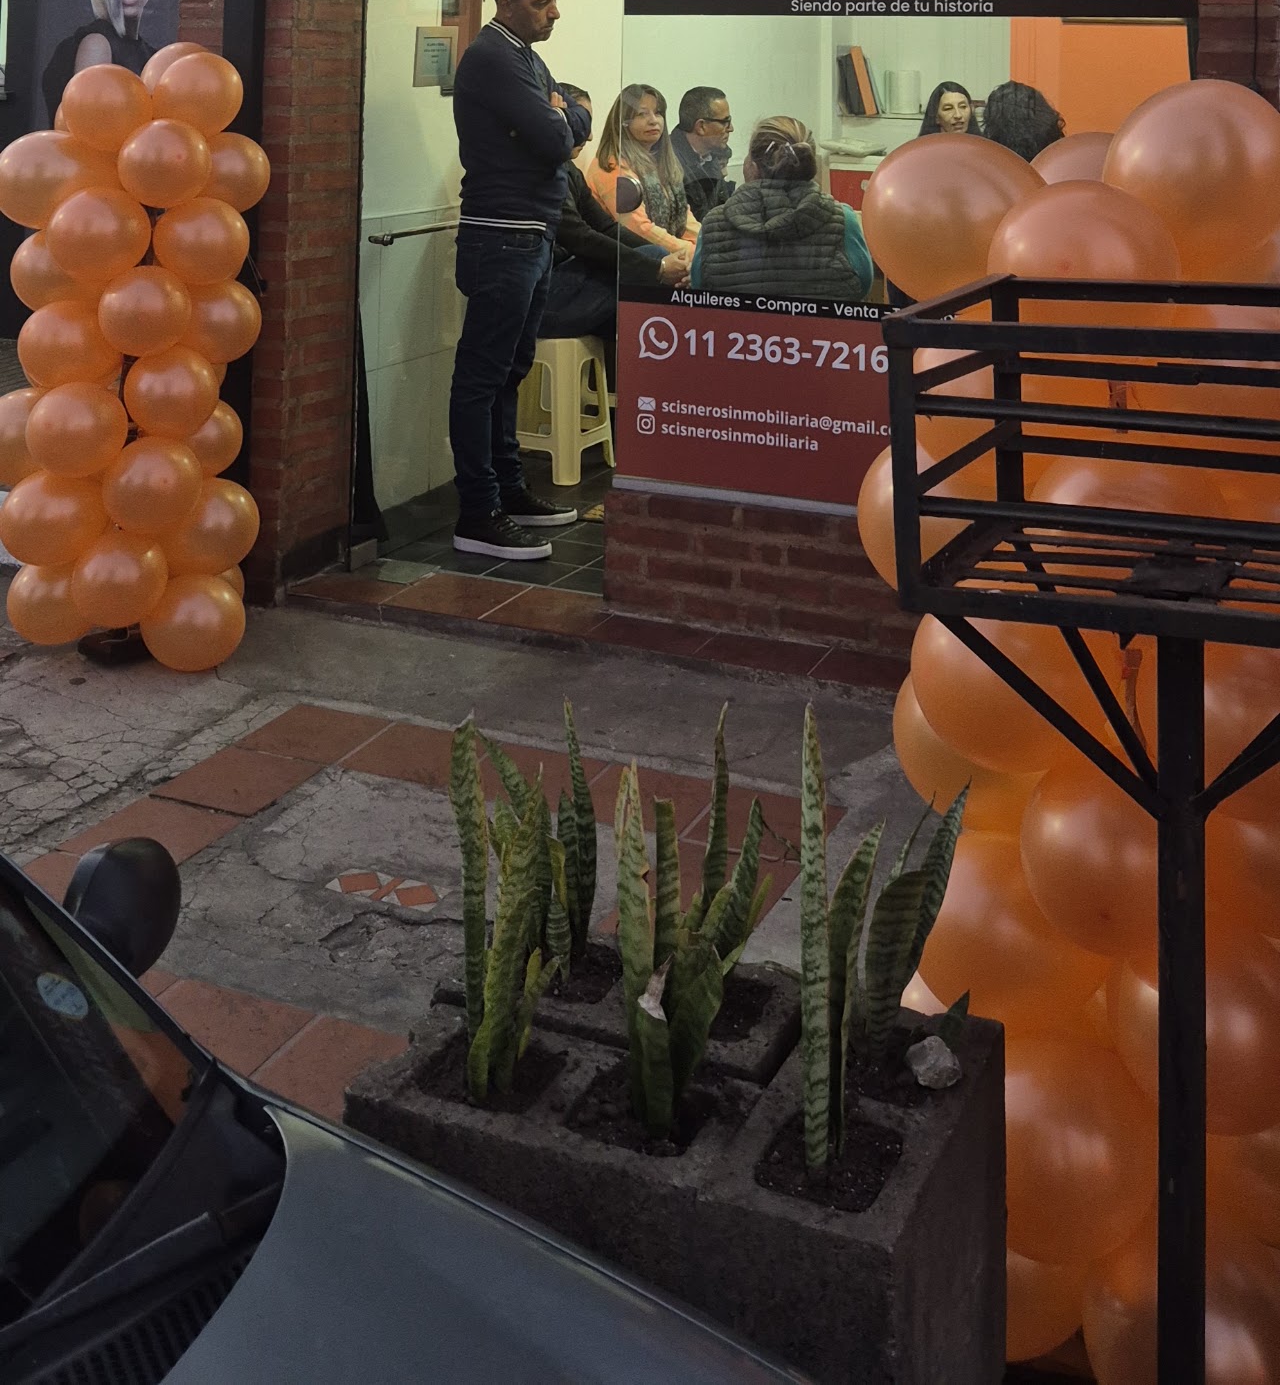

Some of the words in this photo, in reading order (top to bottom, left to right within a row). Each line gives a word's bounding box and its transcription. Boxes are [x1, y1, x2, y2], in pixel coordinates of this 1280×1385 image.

[791, 0, 842, 12] Siendo
[846, 1, 887, 16] parte
[890, 0, 910, 12] de
[914, 1, 930, 13] tu
[934, 0, 994, 13] historia
[671, 290, 740, 308] Alquileres
[755, 297, 817, 316] Compra
[834, 303, 879, 319] Venta
[684, 329, 715, 357] 11
[727, 332, 889, 374] 2363-7216
[661, 422, 819, 451] scisnerosinmobiliaria
